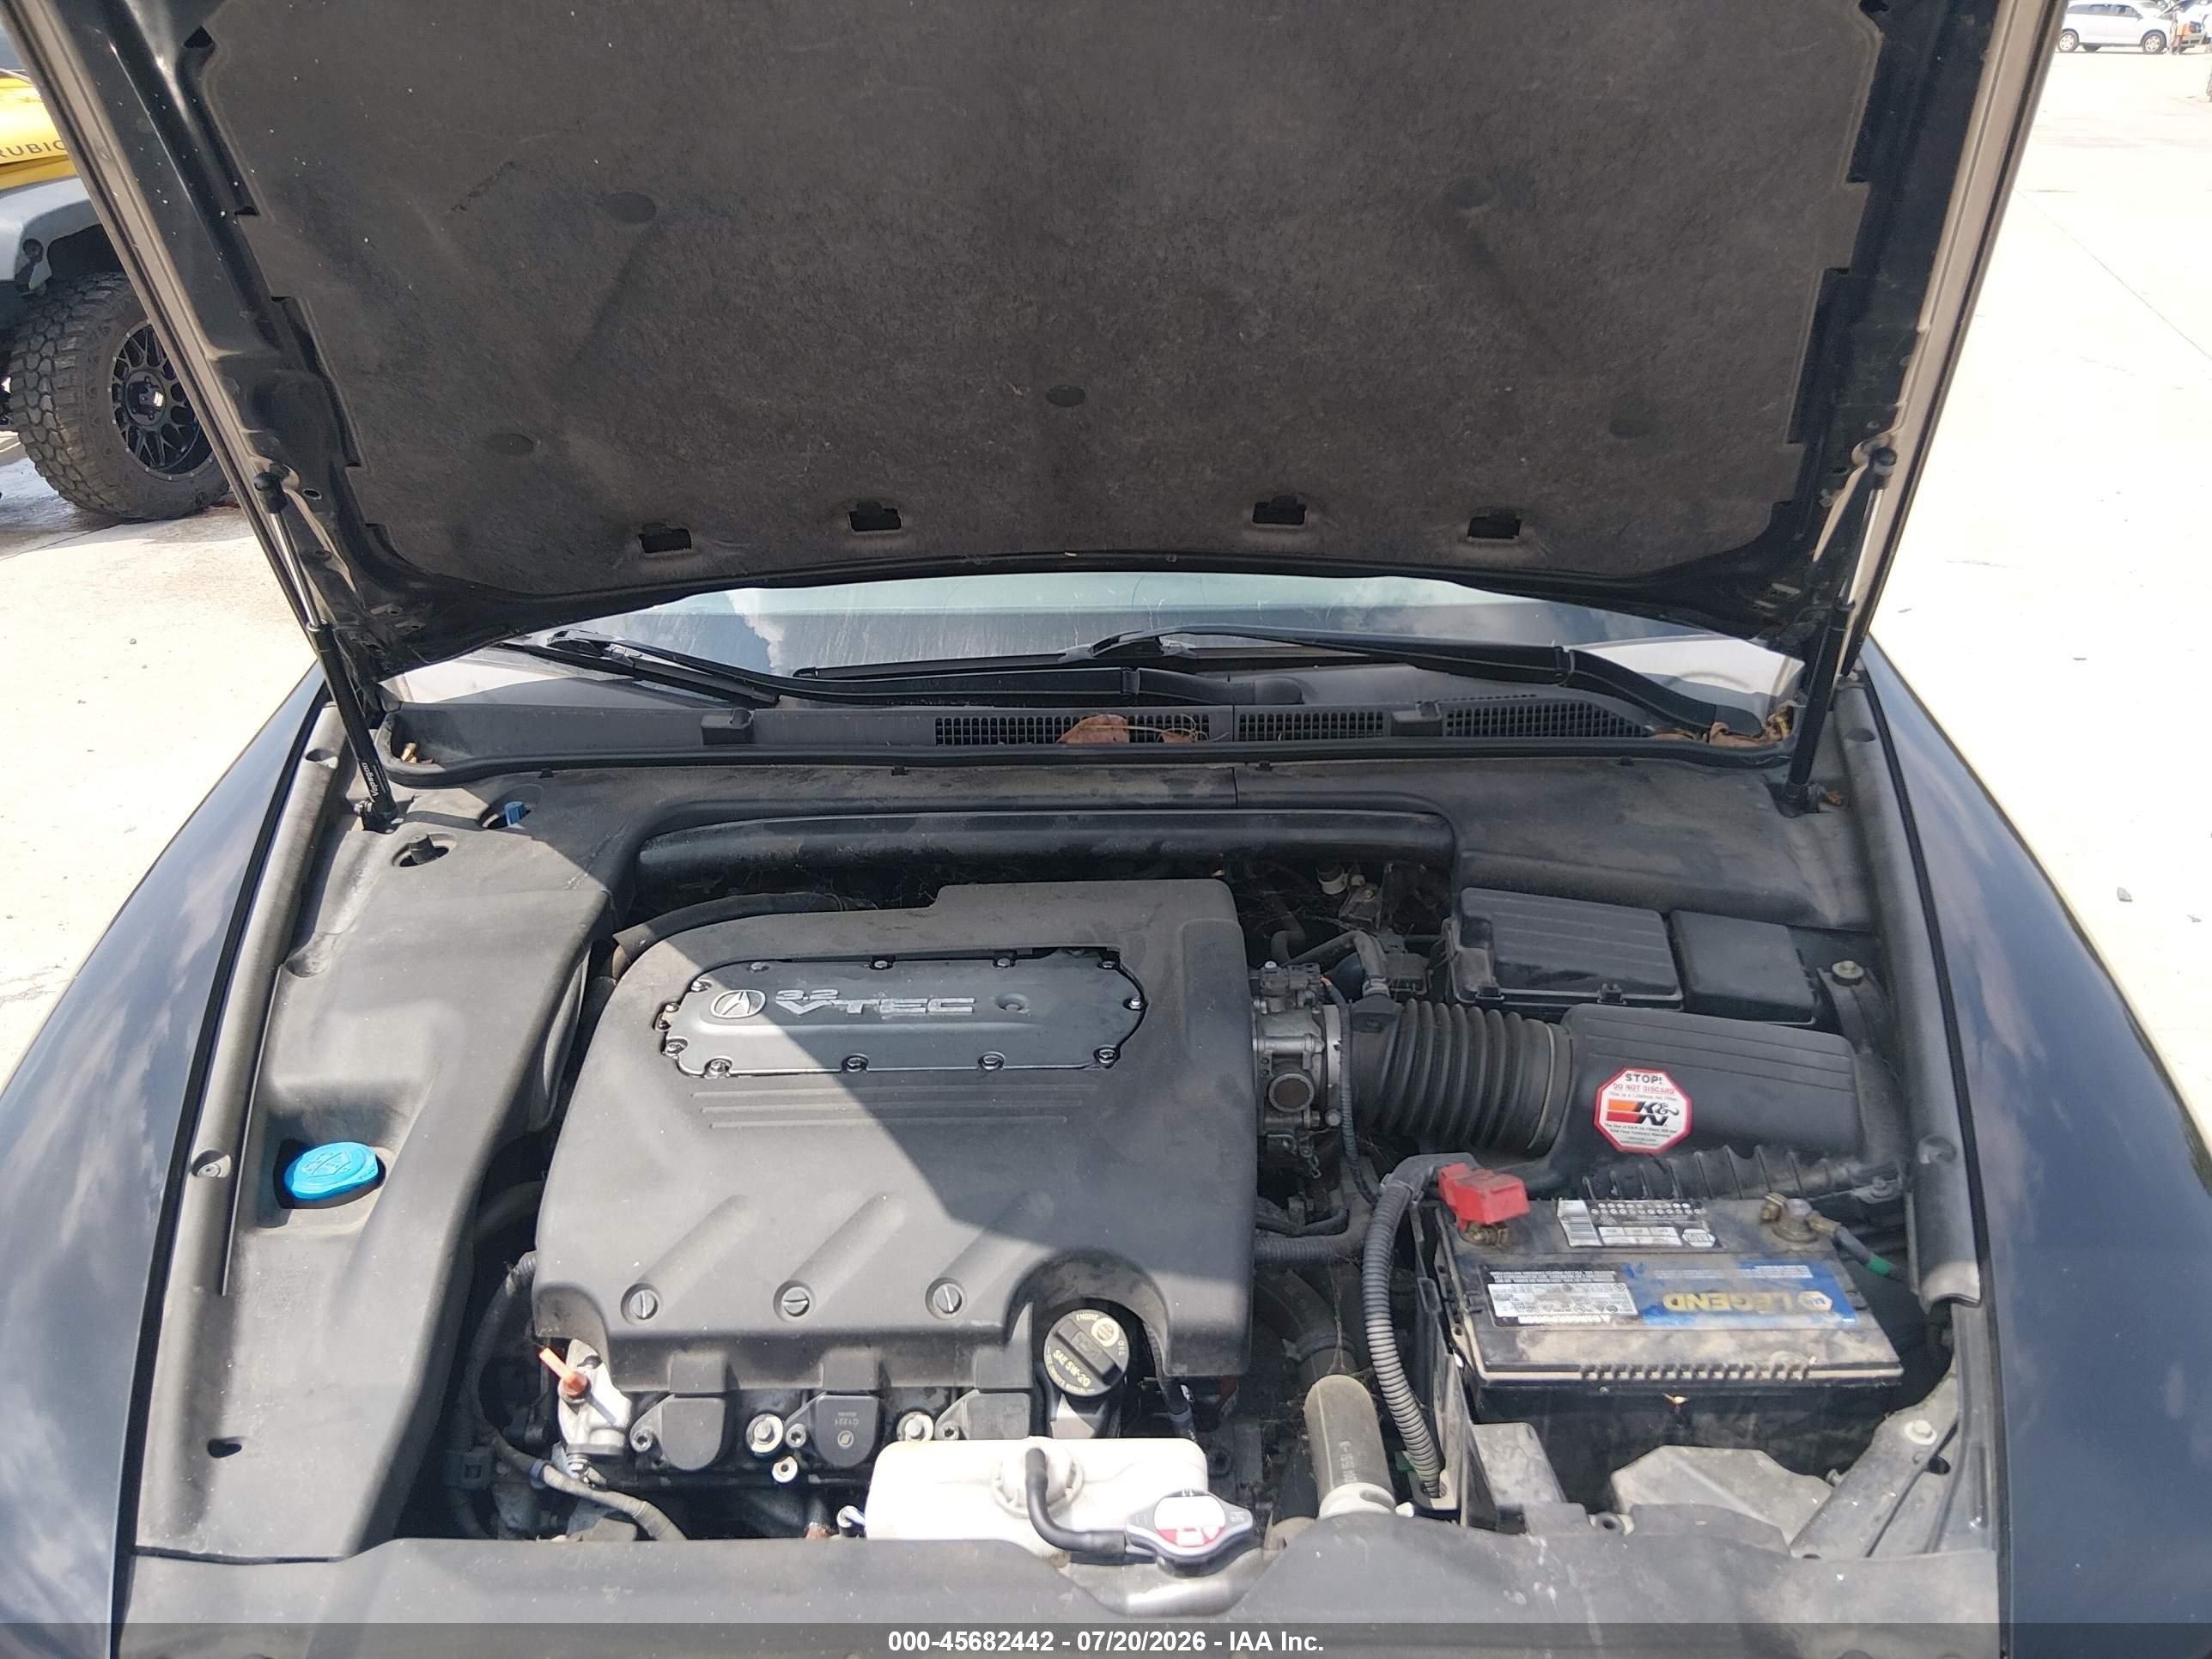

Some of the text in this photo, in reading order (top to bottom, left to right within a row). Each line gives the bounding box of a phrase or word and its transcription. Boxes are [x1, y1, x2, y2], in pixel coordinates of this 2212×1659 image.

[775, 989, 838, 1000] 3.2
[775, 998, 975, 1015] VTEC
[1625, 1073, 1662, 1084] STOP!
[1643, 1085, 1675, 1095] DISCARD
[1637, 1100, 1680, 1127] K&N
[1662, 1291, 1794, 1312] LEGEND
[1117, 1340, 1126, 1356] OIL
[1053, 1349, 1091, 1388] SAE 5W-20
